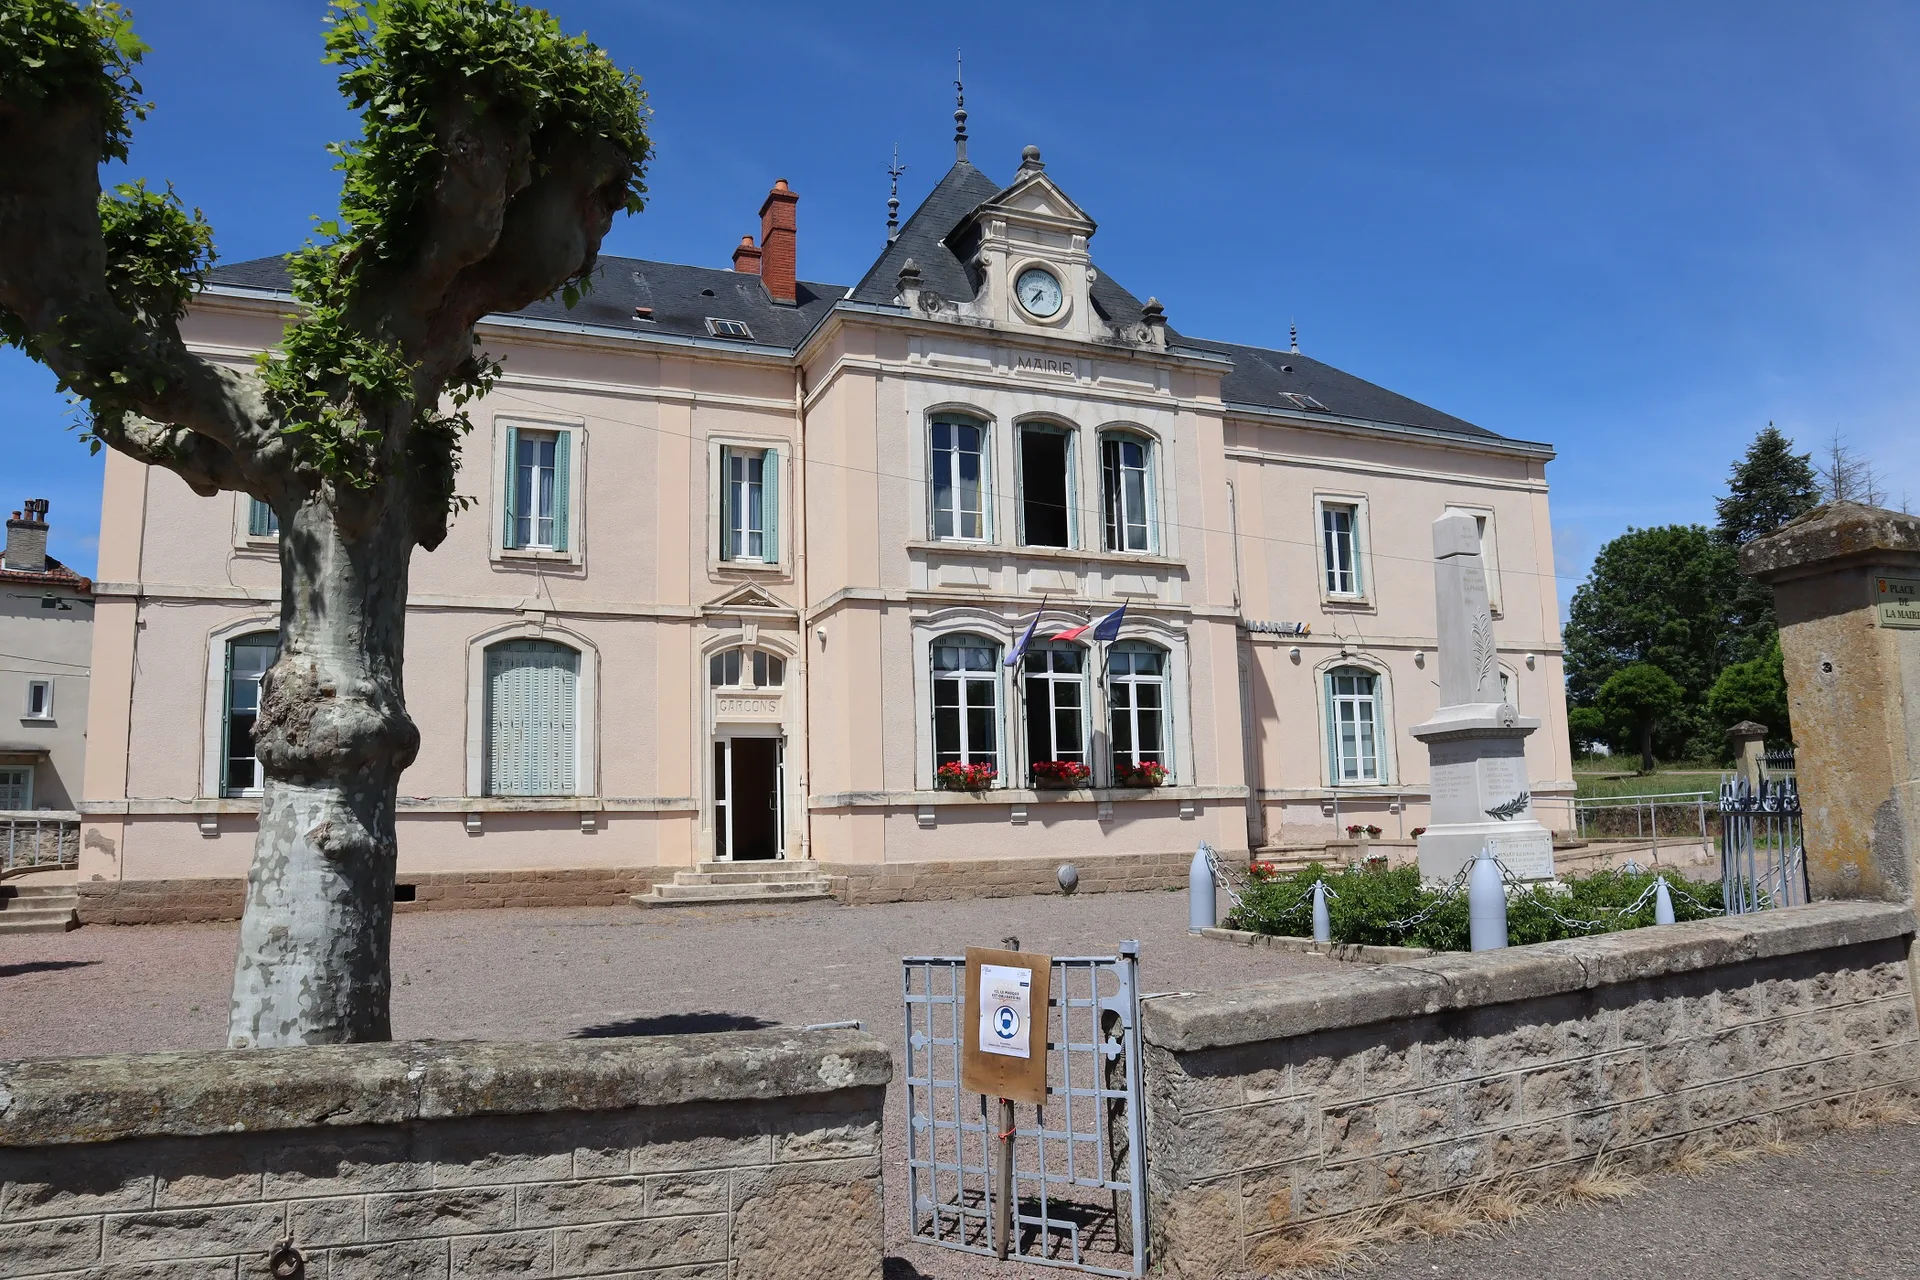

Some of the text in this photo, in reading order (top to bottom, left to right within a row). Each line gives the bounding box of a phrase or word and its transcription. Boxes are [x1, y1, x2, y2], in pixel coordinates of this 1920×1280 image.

[1018, 355, 1073, 375] MAIRIE
[1890, 585, 1915, 594] PLACE
[1898, 597, 1909, 606] DE
[1885, 609, 1896, 618] LA
[1245, 619, 1293, 633] MAIRIE
